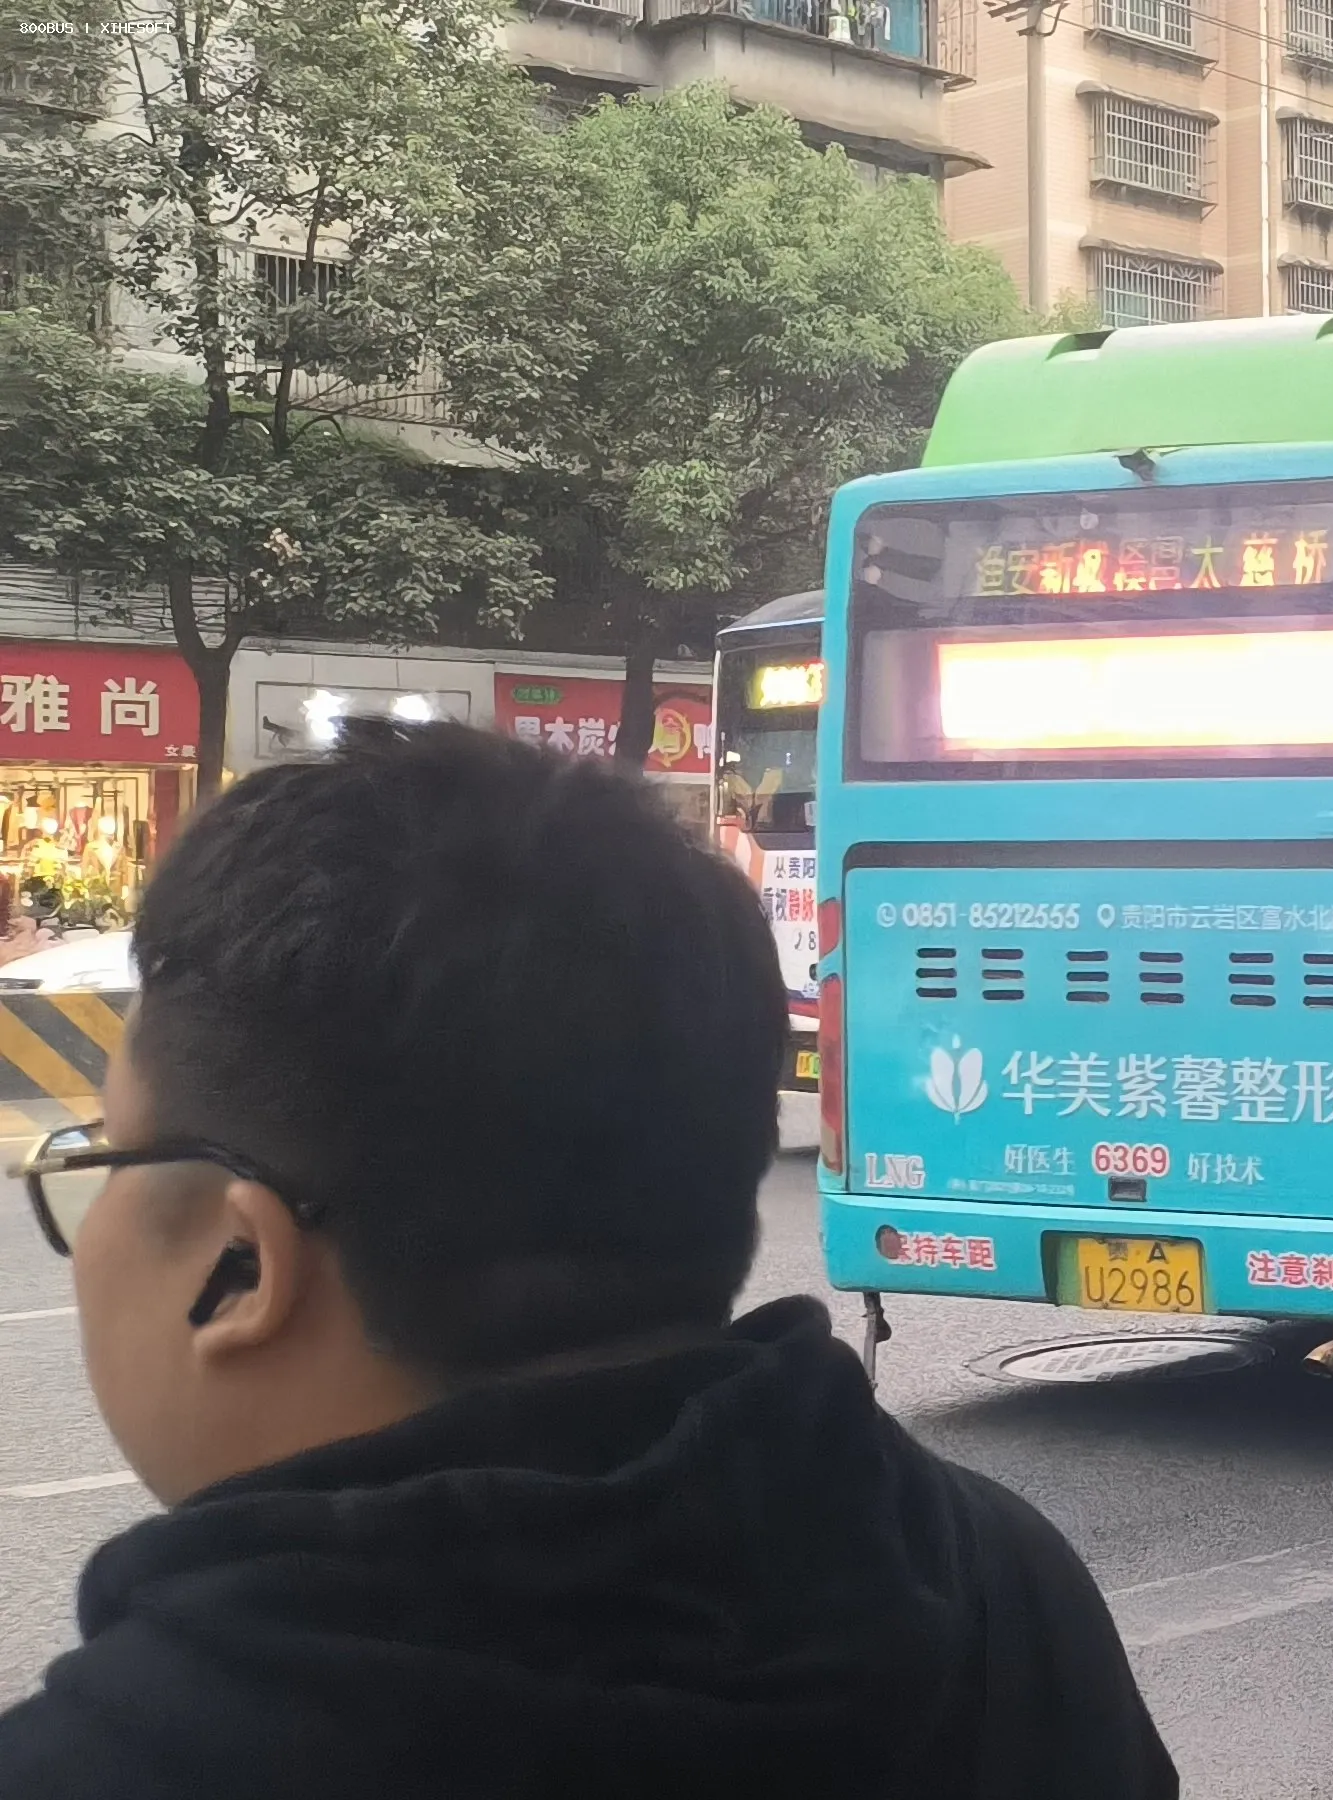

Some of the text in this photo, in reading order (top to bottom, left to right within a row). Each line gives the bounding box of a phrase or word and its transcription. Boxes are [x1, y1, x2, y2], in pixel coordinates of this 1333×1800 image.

[0, 674, 160, 736] 雅尚
[902, 902, 1080, 931] 0851-85212555
[864, 1152, 926, 1189] LNG
[1004, 1143, 1265, 1185] 好医生 6369 好技术
[1084, 1265, 1195, 1307] U2986
